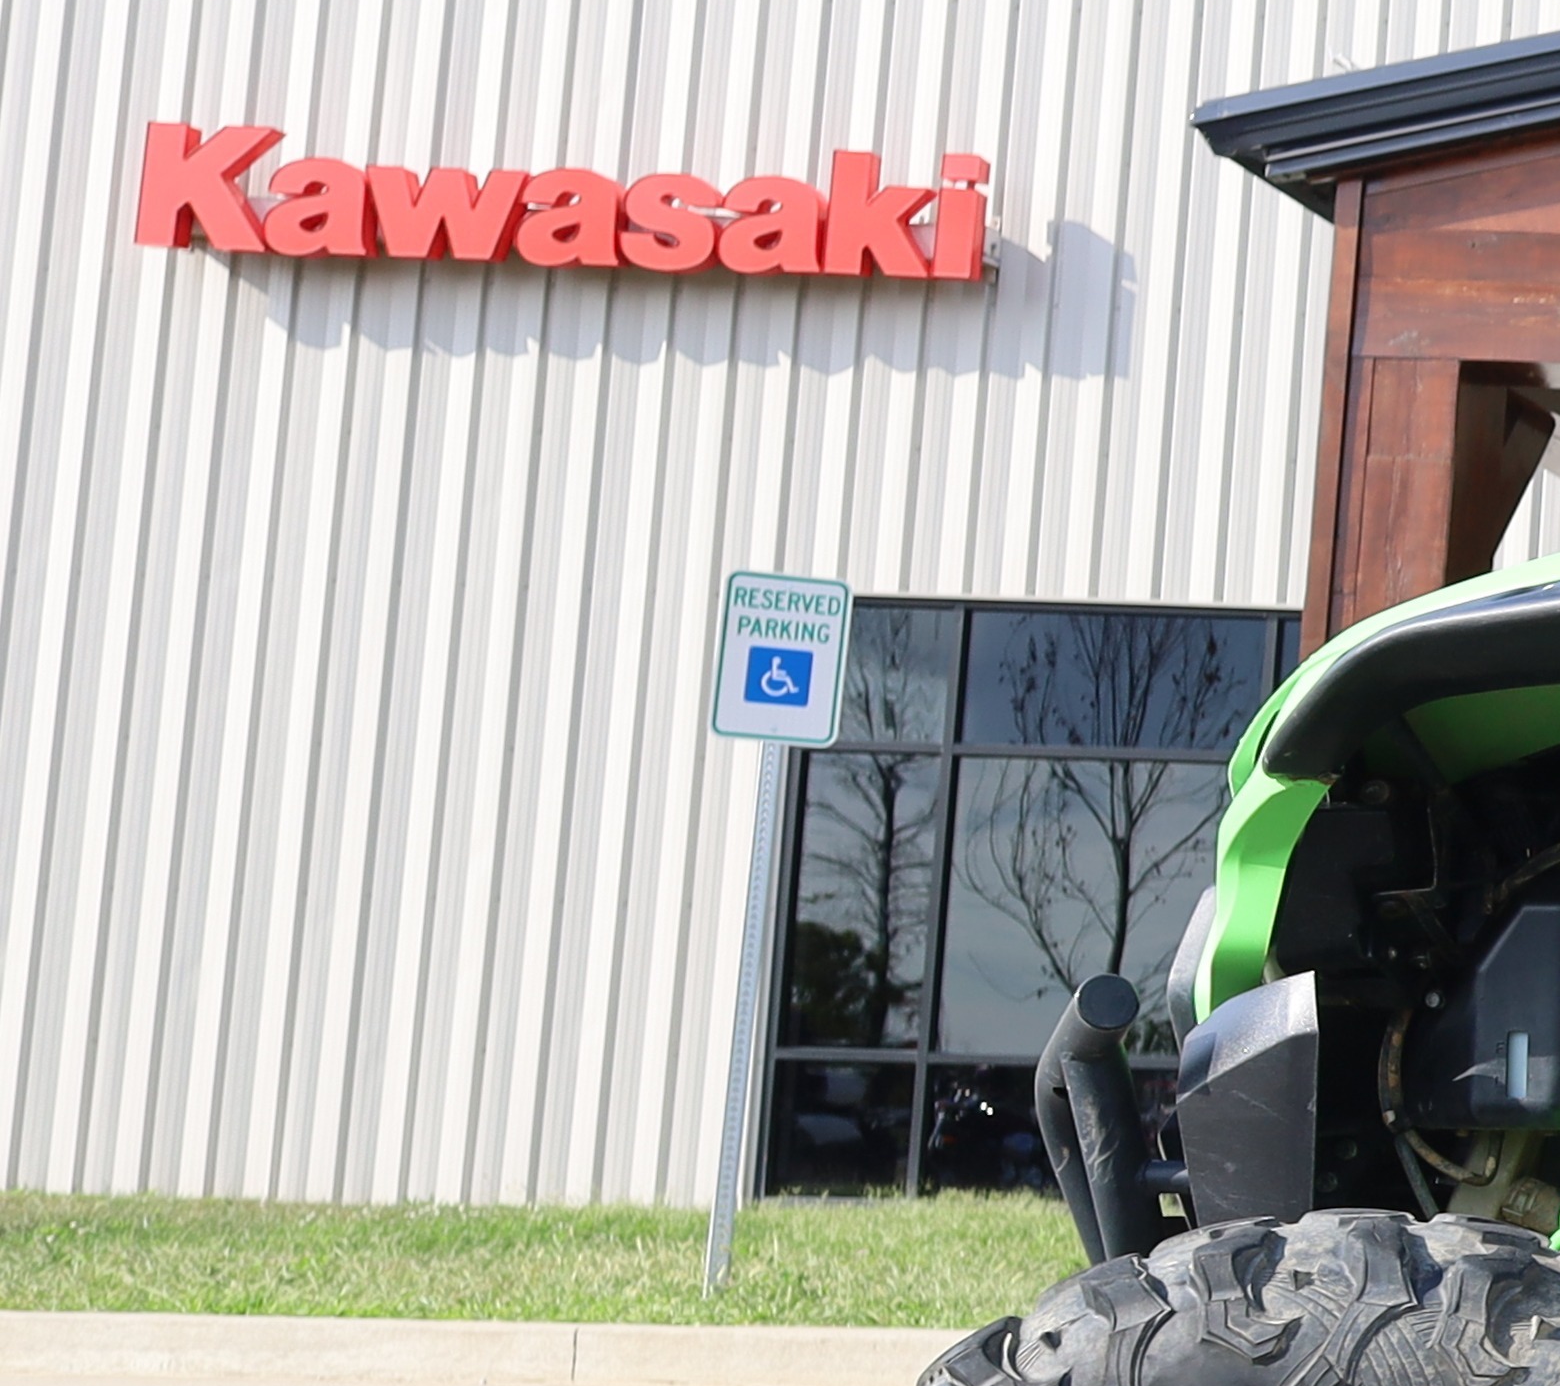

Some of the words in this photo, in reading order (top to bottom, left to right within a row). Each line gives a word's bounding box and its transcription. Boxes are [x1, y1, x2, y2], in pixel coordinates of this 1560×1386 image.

[135, 121, 990, 281] Kawasaki
[733, 586, 841, 616] RESERVED
[737, 615, 831, 644] PARKING
